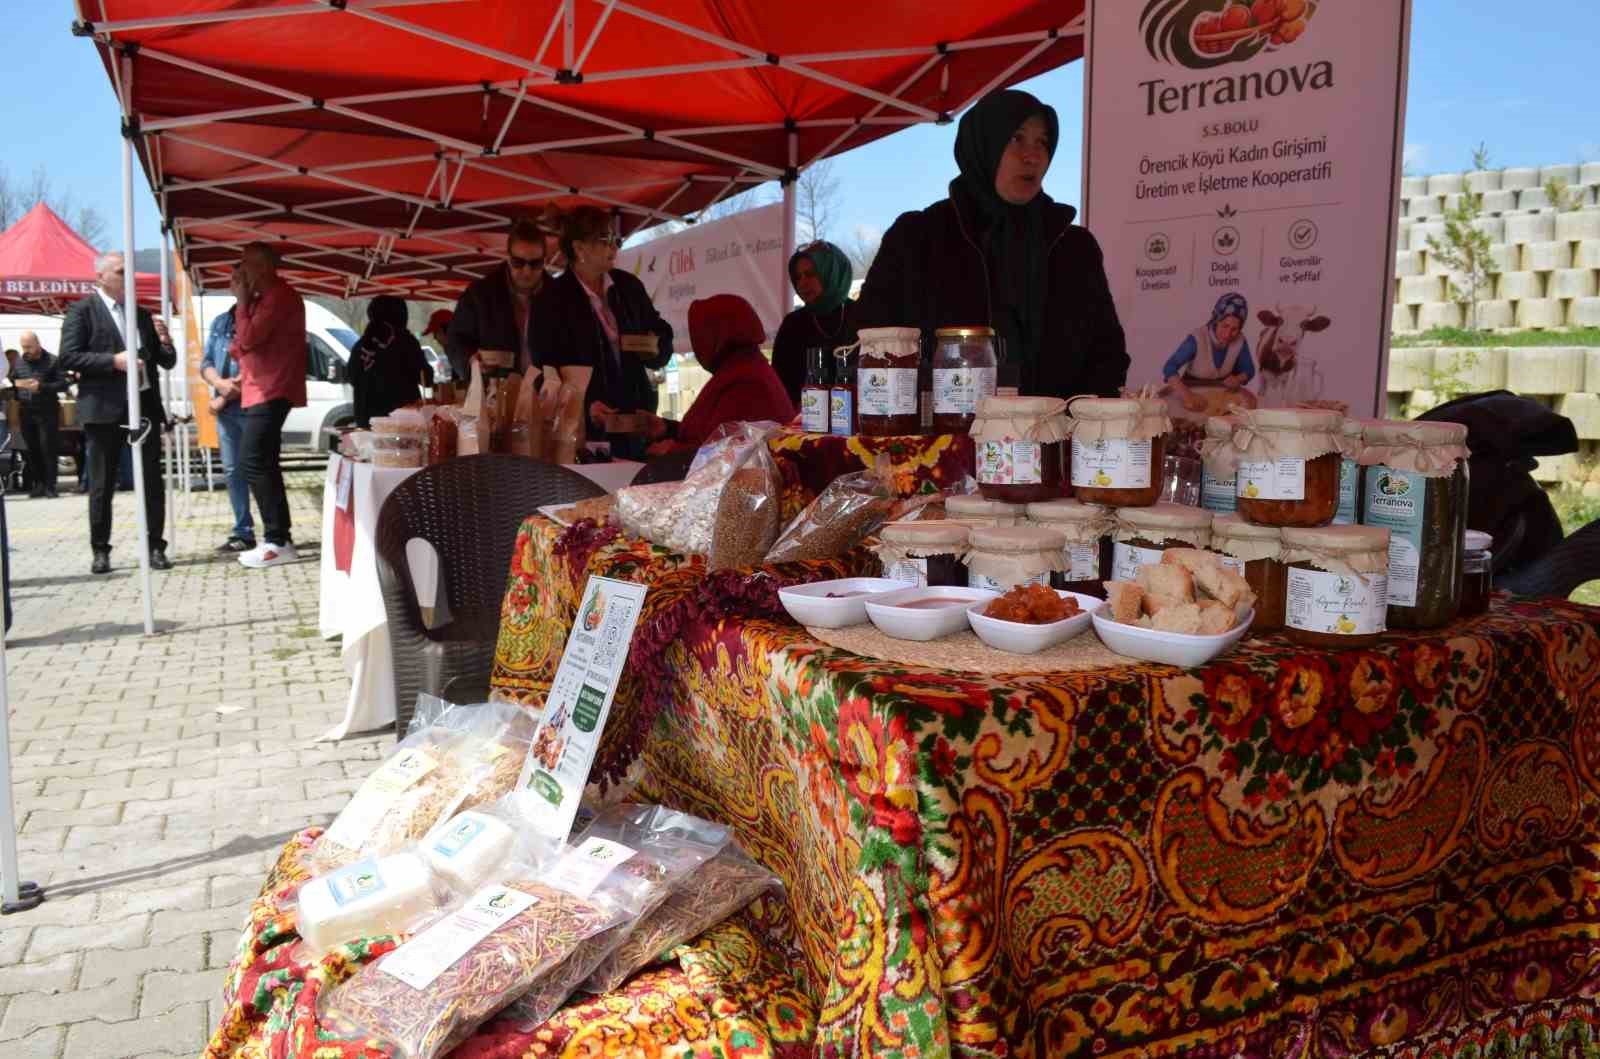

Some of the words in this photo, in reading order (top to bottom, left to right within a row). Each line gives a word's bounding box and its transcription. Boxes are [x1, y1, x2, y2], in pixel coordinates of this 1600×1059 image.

[1138, 60, 1334, 116] Terranova
[1202, 119, 1260, 138] S.S.BOLU
[1139, 151, 1189, 175] Örencik
[1192, 147, 1225, 169] Köyü
[1228, 144, 1269, 164] Kadın
[1272, 136, 1327, 159] Girişimi
[1135, 178, 1179, 200] Üretim
[1182, 180, 1196, 195] ve
[1199, 172, 1249, 195] İşletme
[1252, 161, 1332, 187] Kooperatifi
[1211, 262, 1239, 273] Doğal
[1279, 256, 1322, 268] Güvenilir
[1135, 265, 1177, 278] Kooperatif
[1279, 273, 1290, 283] ve
[1292, 270, 1321, 285] Şeffaf
[1208, 275, 1240, 287] Üretim
[1372, 494, 1414, 508] Terranova
